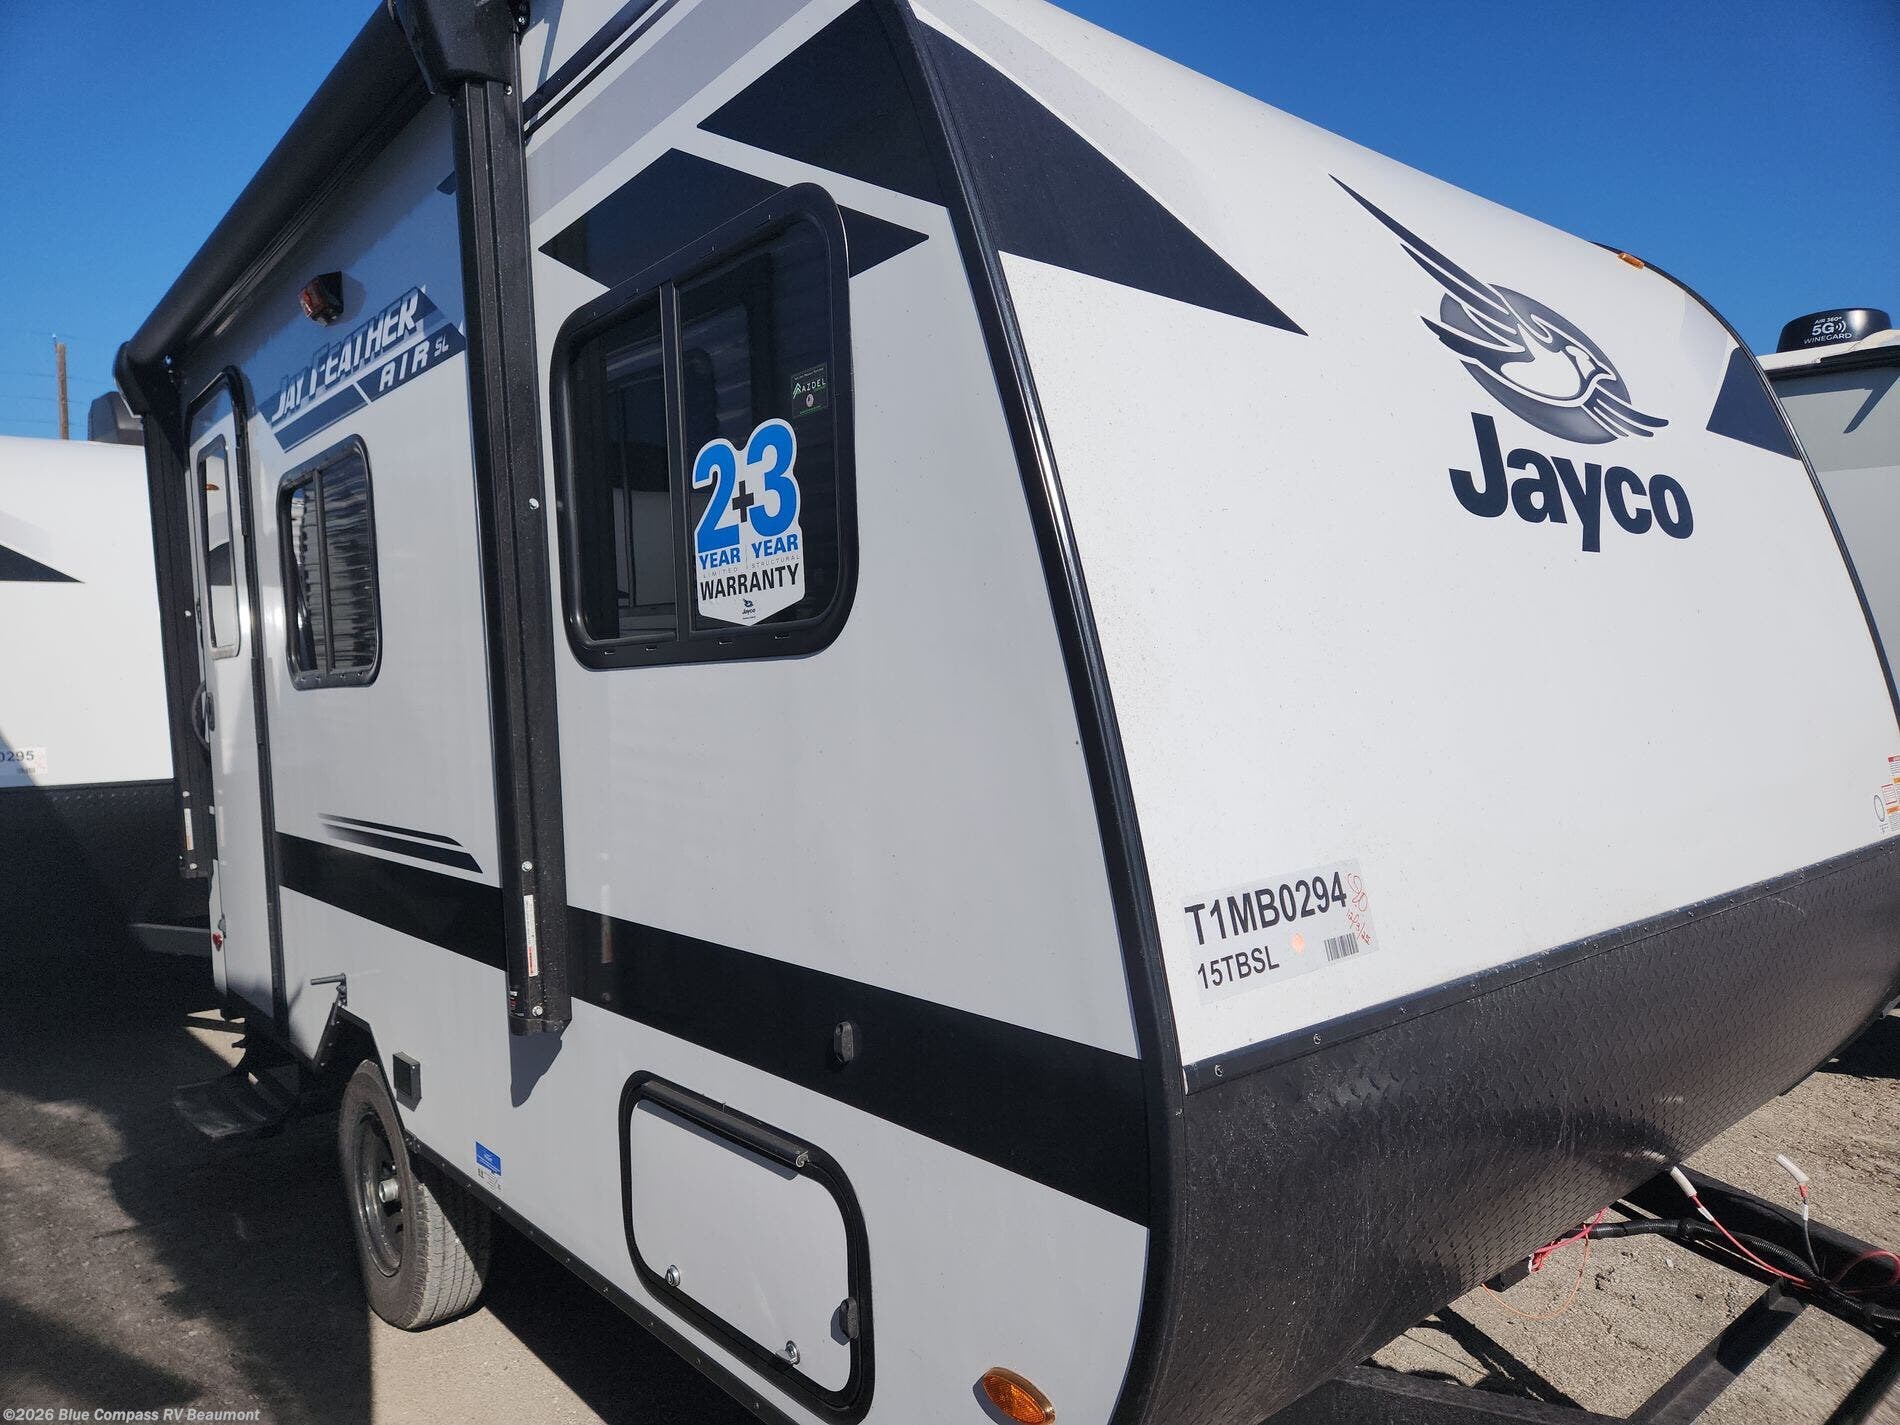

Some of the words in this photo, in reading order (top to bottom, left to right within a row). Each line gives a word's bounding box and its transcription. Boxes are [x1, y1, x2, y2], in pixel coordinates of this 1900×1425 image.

[1803, 332, 1852, 344] WINEGARD
[1811, 322, 1835, 336] 5G
[271, 374, 304, 421] JAY
[309, 286, 422, 397] FEATHER
[379, 340, 430, 392] AIR
[434, 334, 449, 357] SL
[1448, 411, 1694, 553] Jayco
[699, 547, 741, 570] YEAR
[751, 534, 799, 559] YEAR
[704, 566, 738, 579] LIMITED
[751, 554, 801, 569] STRUCTURAL
[700, 562, 800, 601] WARRANTY
[1184, 872, 1347, 945] T1MB0294
[1197, 946, 1280, 989] 15TBSL
